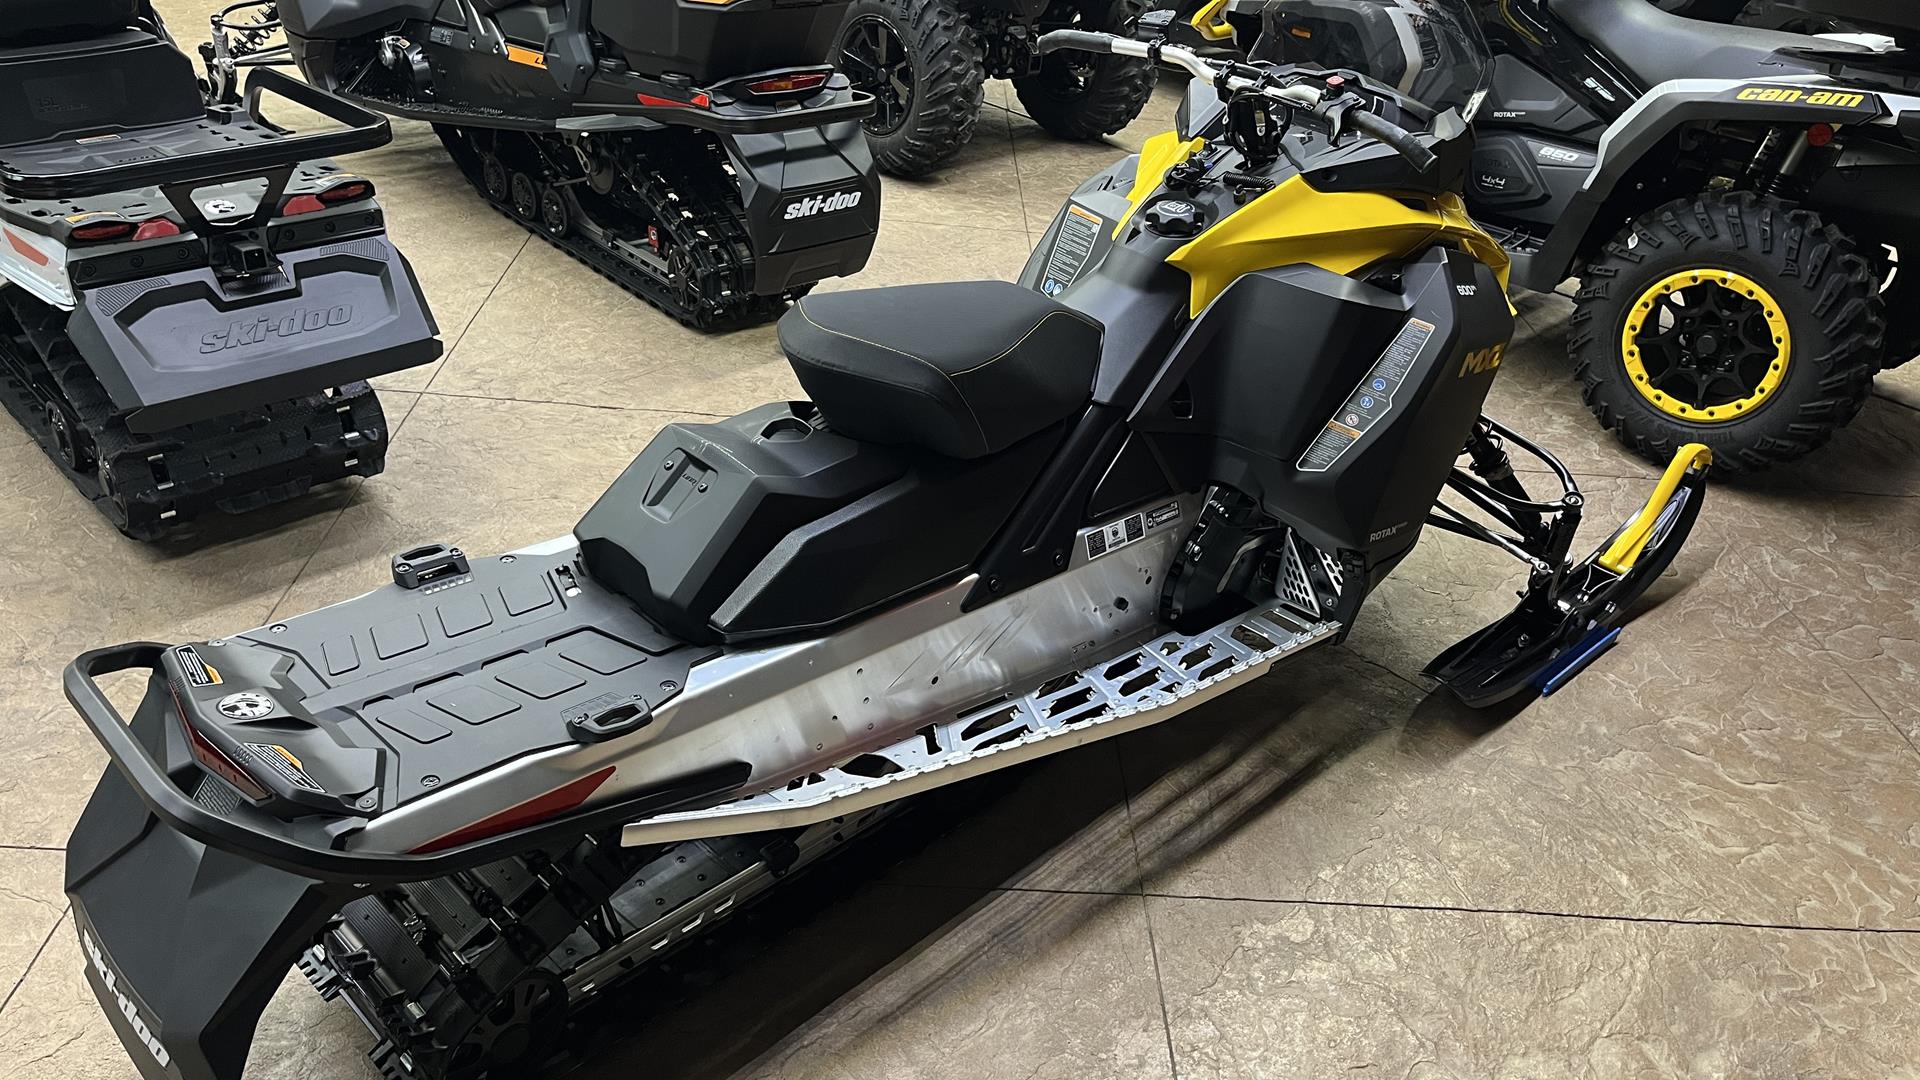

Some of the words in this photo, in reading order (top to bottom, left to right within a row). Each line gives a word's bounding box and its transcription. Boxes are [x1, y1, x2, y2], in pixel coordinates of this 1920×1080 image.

[1736, 88, 1864, 107] can-am
[1539, 146, 1579, 161] 850
[1481, 175, 1506, 186] 4x4
[783, 192, 862, 219] ski-doo
[200, 304, 353, 354] ski-doo
[1369, 526, 1397, 543] ROTAX
[83, 928, 170, 1069] ski-doo
